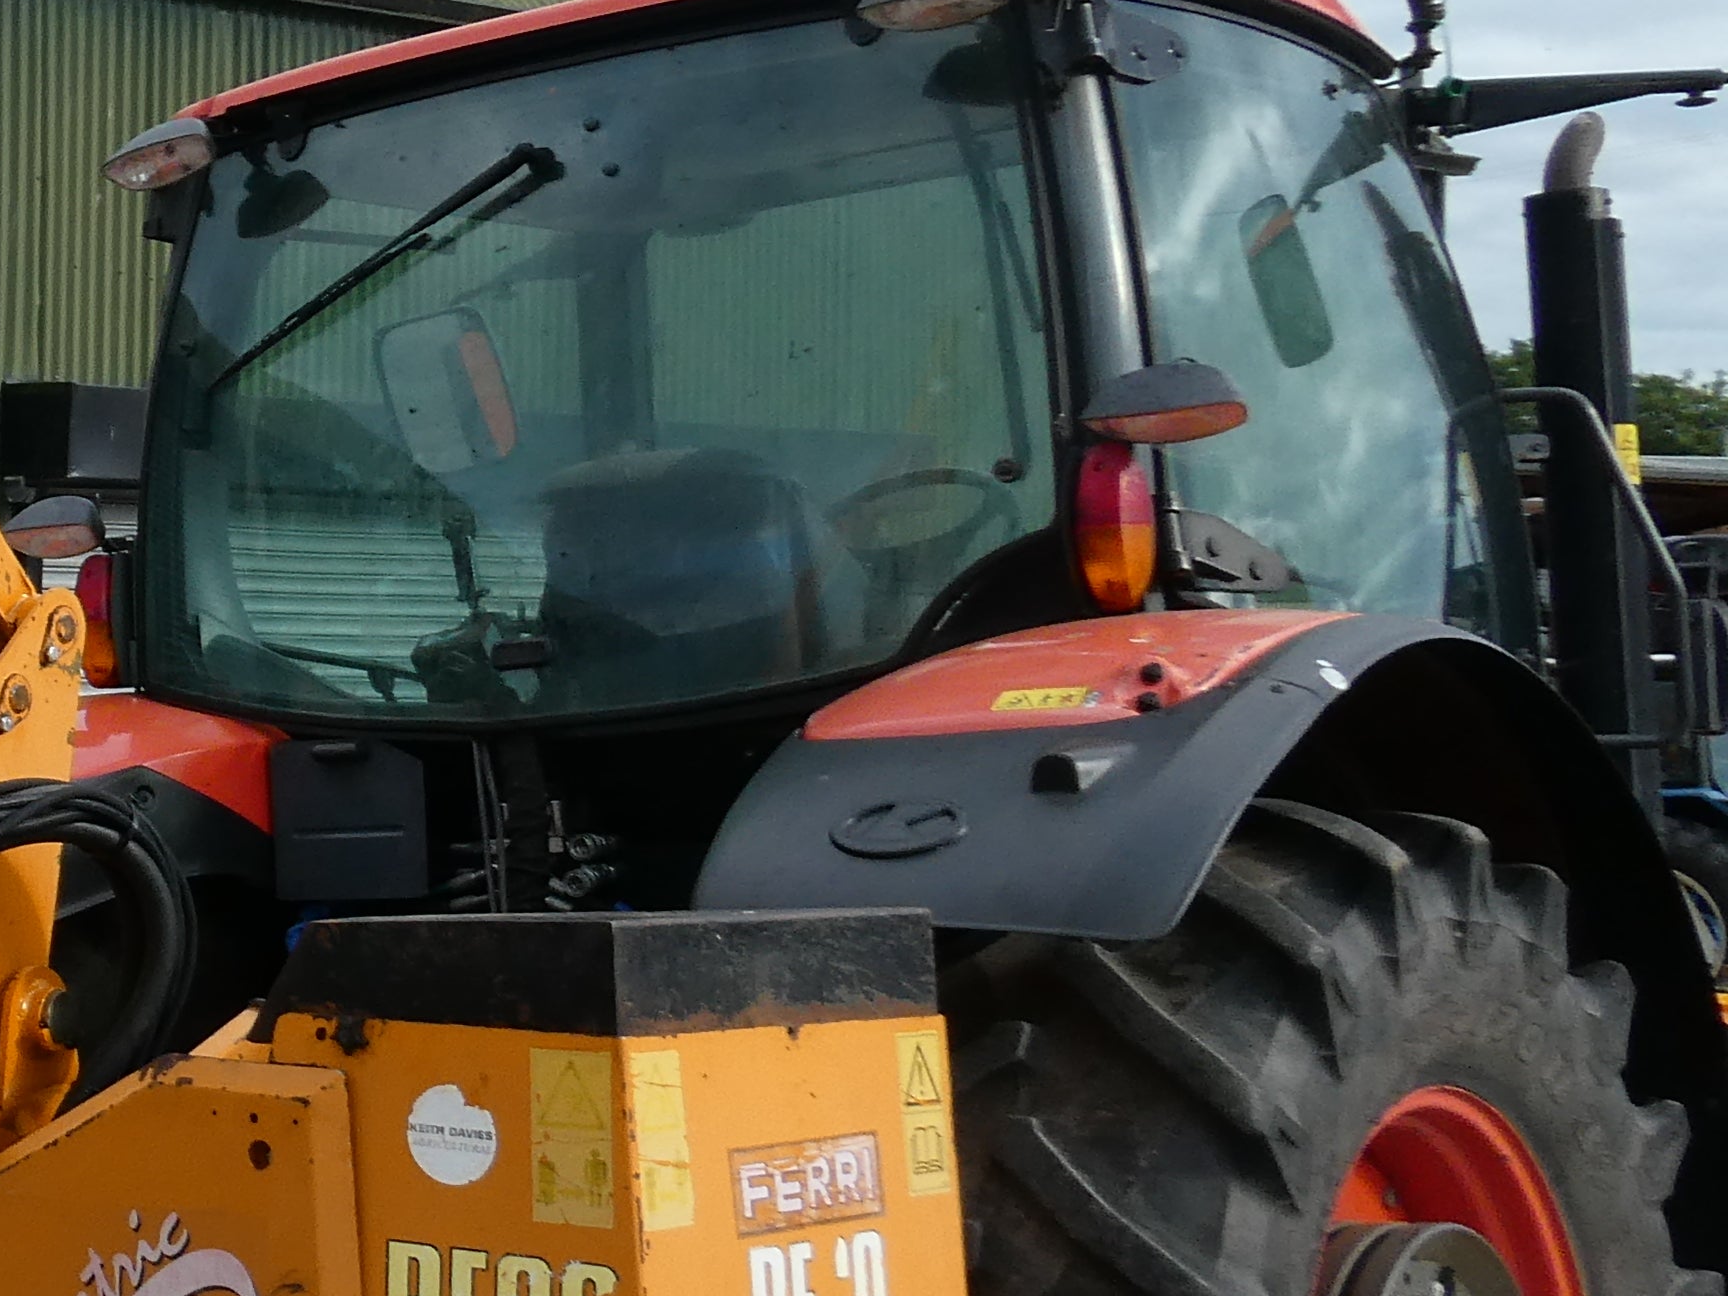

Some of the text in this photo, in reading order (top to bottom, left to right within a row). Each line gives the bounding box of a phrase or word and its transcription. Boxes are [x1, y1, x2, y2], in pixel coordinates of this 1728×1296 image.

[410, 1123, 493, 1141] KEITH DAVIES
[739, 1146, 876, 1219] FERRI
